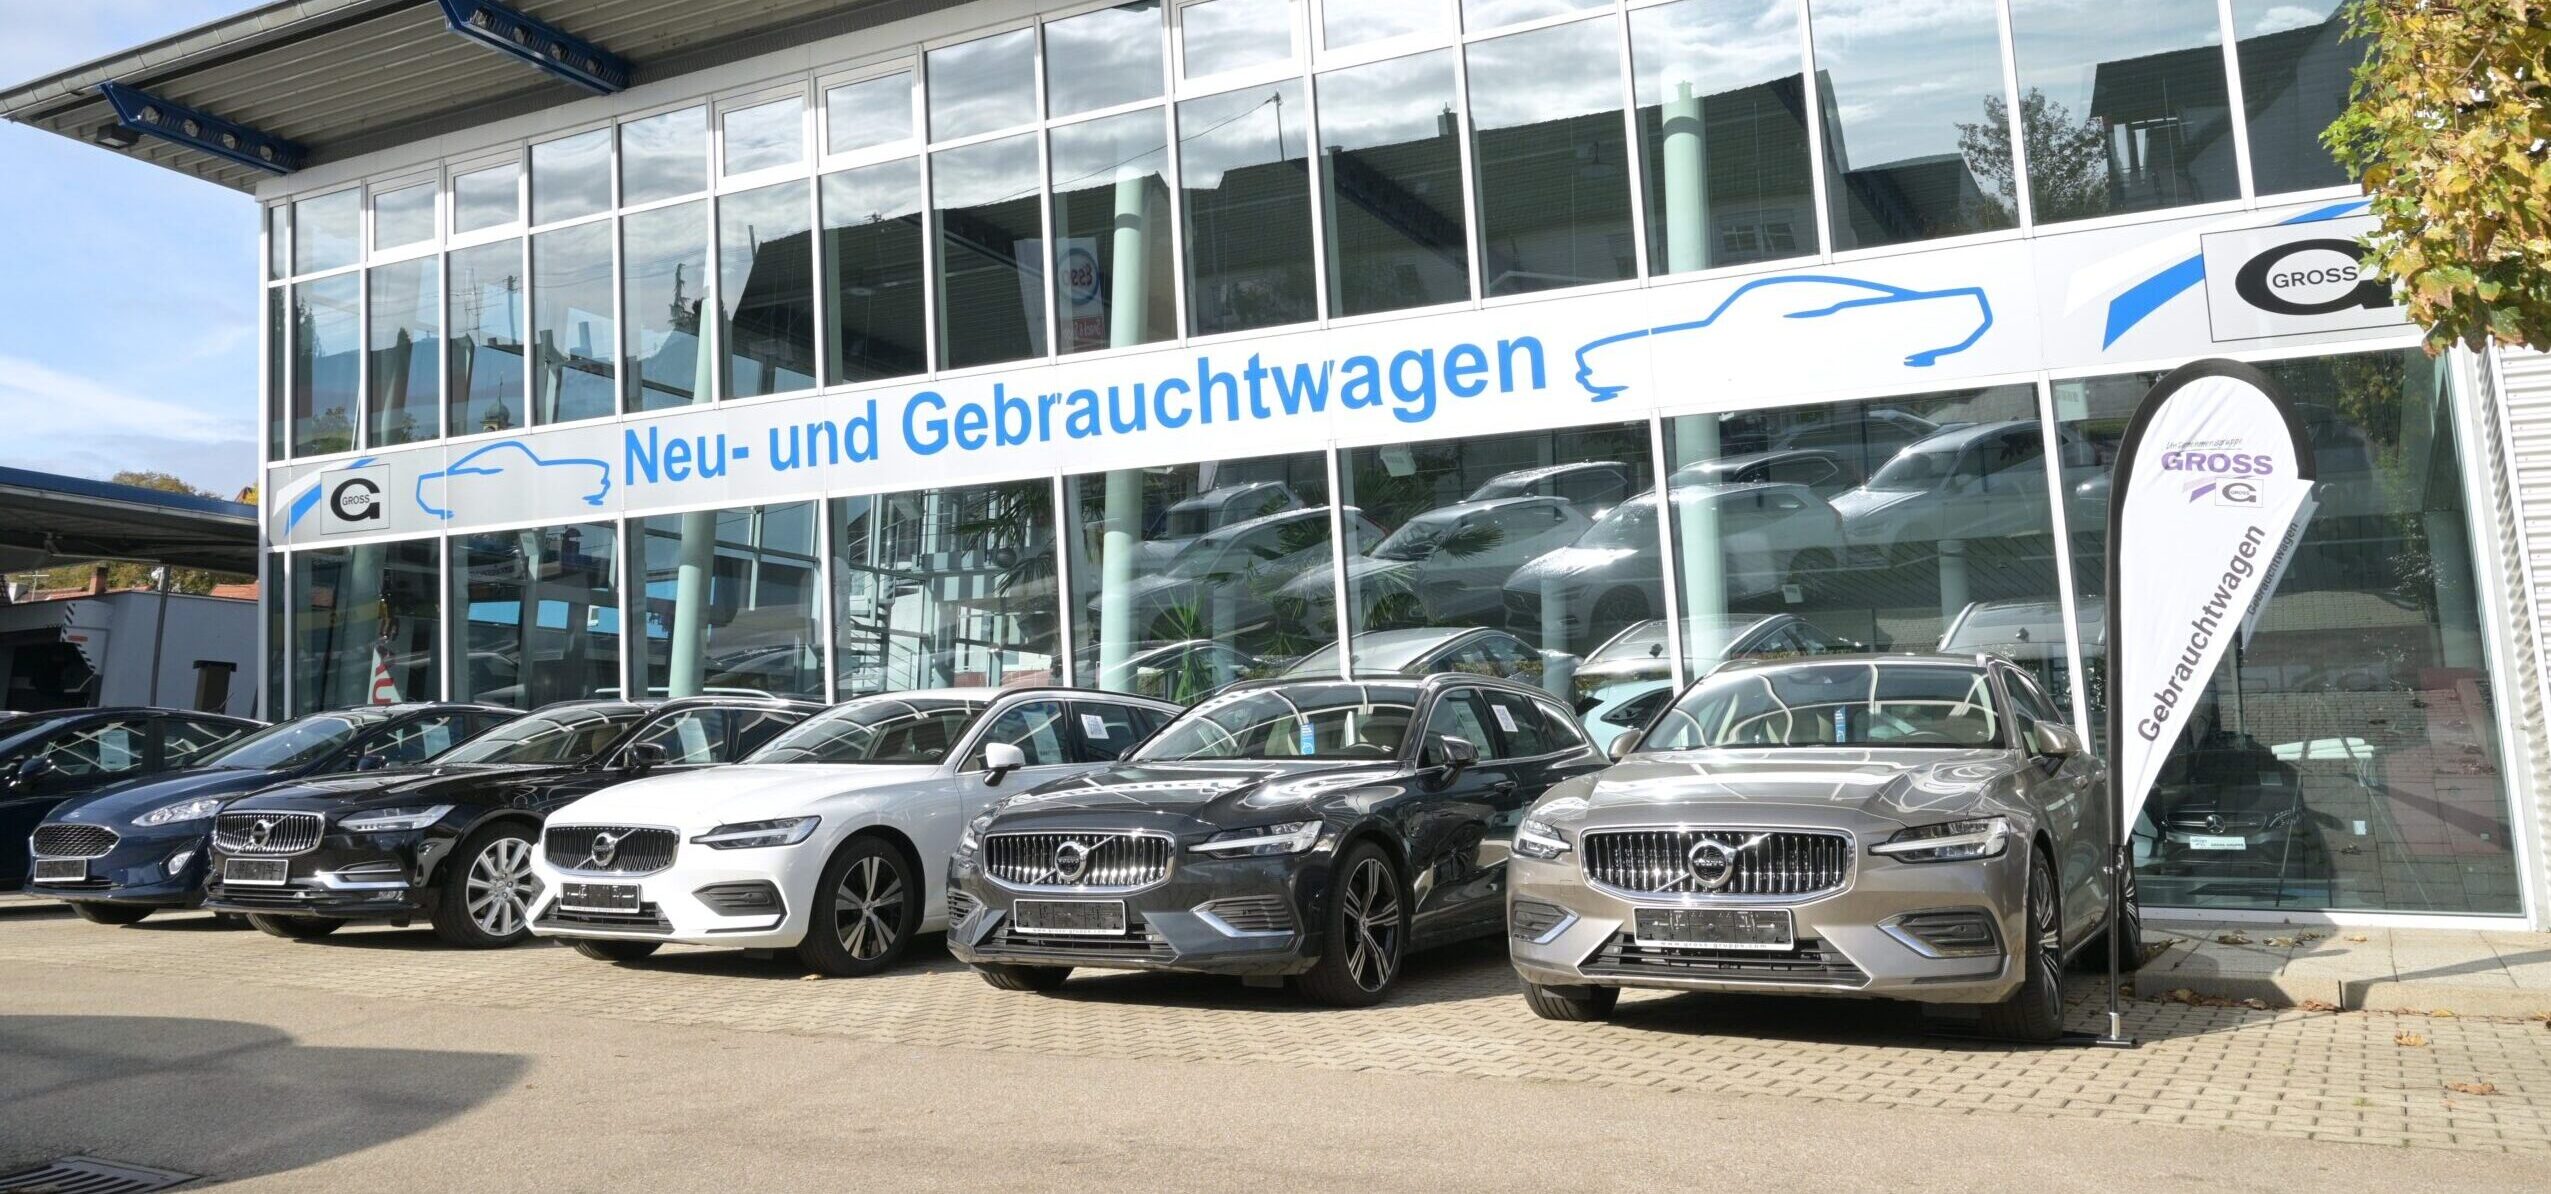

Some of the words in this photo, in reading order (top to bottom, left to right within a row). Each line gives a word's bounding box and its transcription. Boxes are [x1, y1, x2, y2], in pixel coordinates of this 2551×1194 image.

[2272, 265, 2358, 289] GROSS
[624, 425, 750, 486] Neu-
[769, 399, 879, 471] und
[902, 335, 1547, 455] Gebrauchtwagen
[2160, 451, 2274, 475] GROSS
[341, 494, 371, 506] GROSS
[2247, 522, 2299, 615] Gebrauchtwagen
[2137, 525, 2266, 742] Gebrauchtwagen
